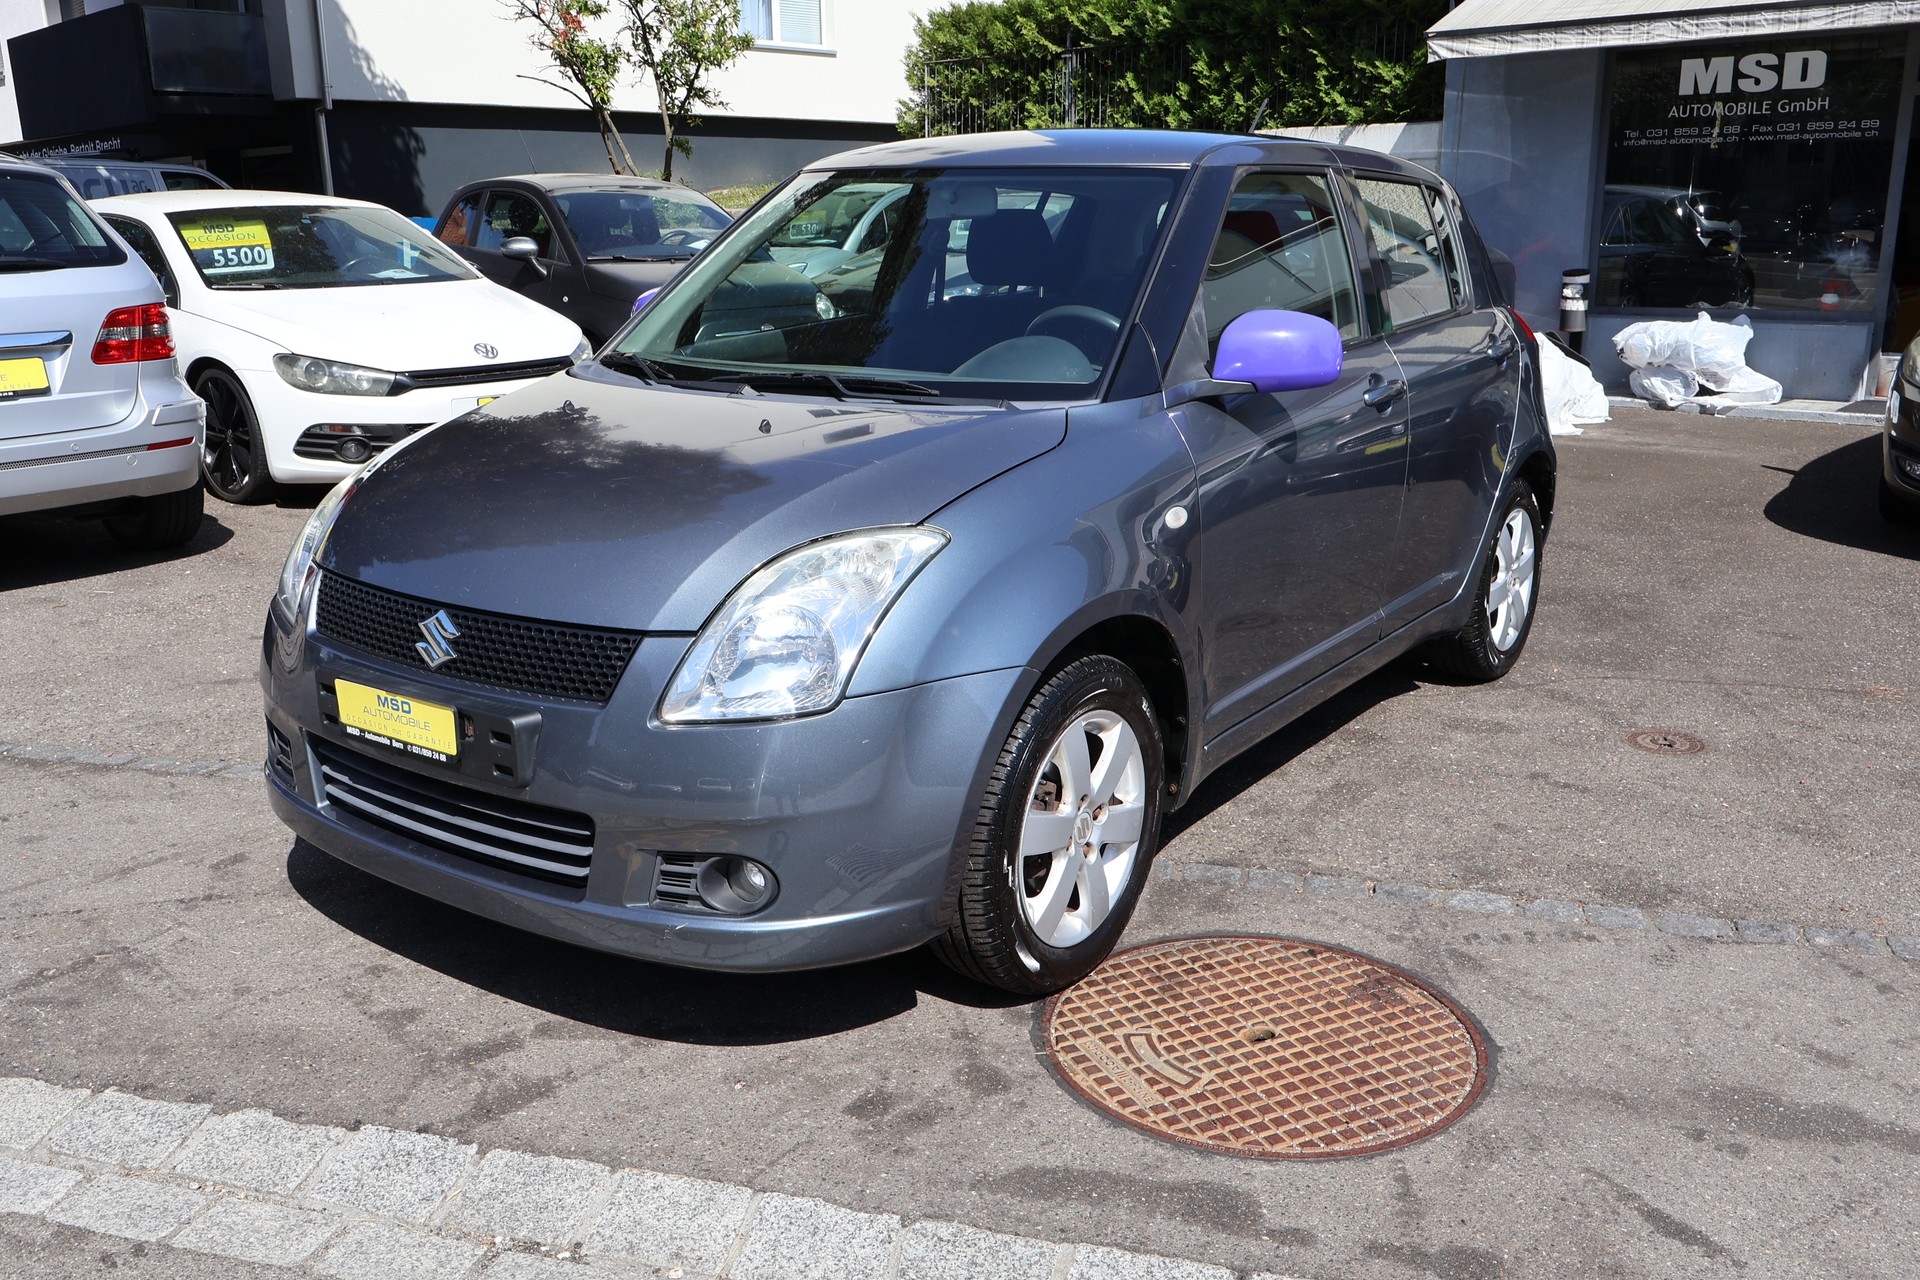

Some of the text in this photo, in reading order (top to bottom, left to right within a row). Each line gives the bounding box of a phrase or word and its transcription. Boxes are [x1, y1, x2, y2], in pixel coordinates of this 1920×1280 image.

[1678, 50, 1828, 96] MSD
[1668, 97, 1829, 118] AUTOMOBILE GmbH
[1624, 130, 1642, 138] Tel.
[1646, 128, 1668, 137] 031
[1674, 127, 1699, 136] 859
[1723, 125, 1741, 134] 88
[1752, 124, 1773, 132] Fax
[1776, 123, 1800, 132] 031
[1806, 121, 1834, 131] 859
[1838, 120, 1856, 129] 24
[1861, 119, 1880, 128] 89
[96, 137, 121, 152] Brecht
[187, 232, 256, 243] OCCASION
[203, 223, 235, 234] MSD
[213, 246, 266, 267] 5500
[377, 694, 412, 715] MSD
[362, 706, 431, 731] AUTOMOBILE
[346, 713, 389, 732] OCCASION
[406, 731, 452, 749] GARANTIE
[346, 725, 360, 736] MSD
[364, 731, 391, 746] Automobile
[392, 740, 404, 750] Bern
